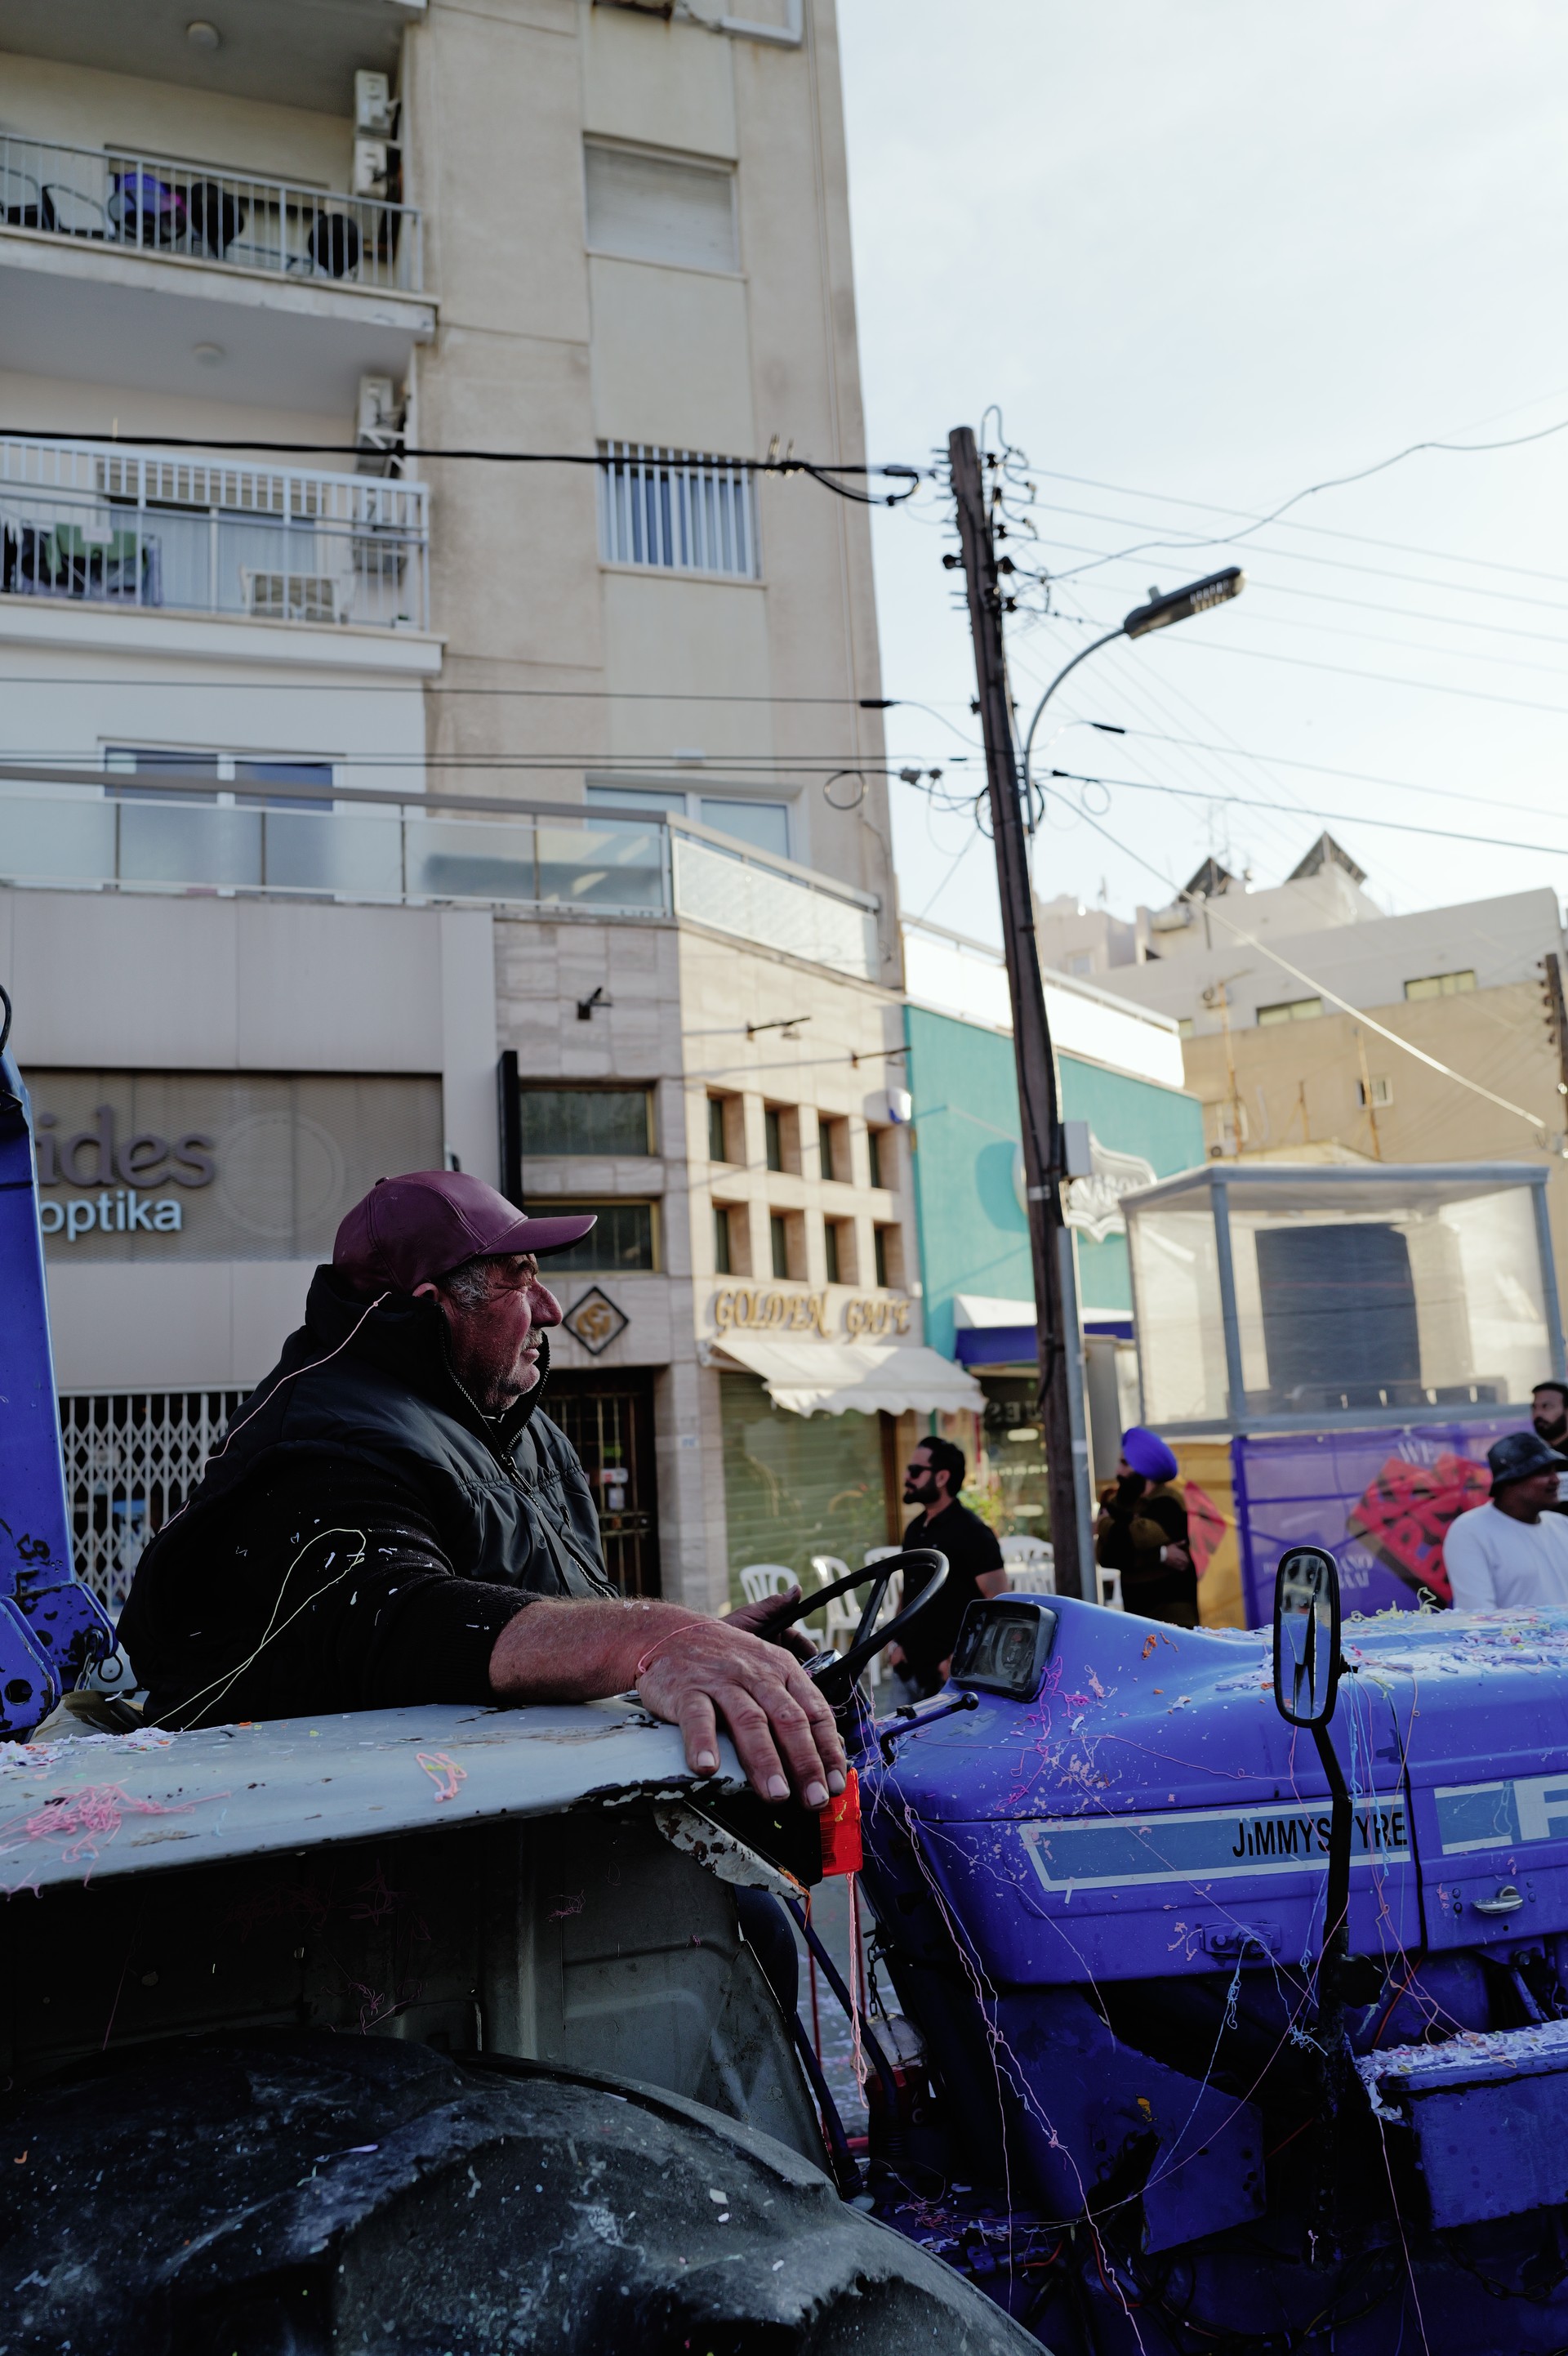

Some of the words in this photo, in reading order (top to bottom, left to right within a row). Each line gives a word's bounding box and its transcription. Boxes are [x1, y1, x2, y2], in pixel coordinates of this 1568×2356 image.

[41, 1190, 182, 1242] optika
[715, 1287, 831, 1338] GOLDEN
[844, 1297, 911, 1345] GATE
[1351, 1811, 1408, 1850] YRE
